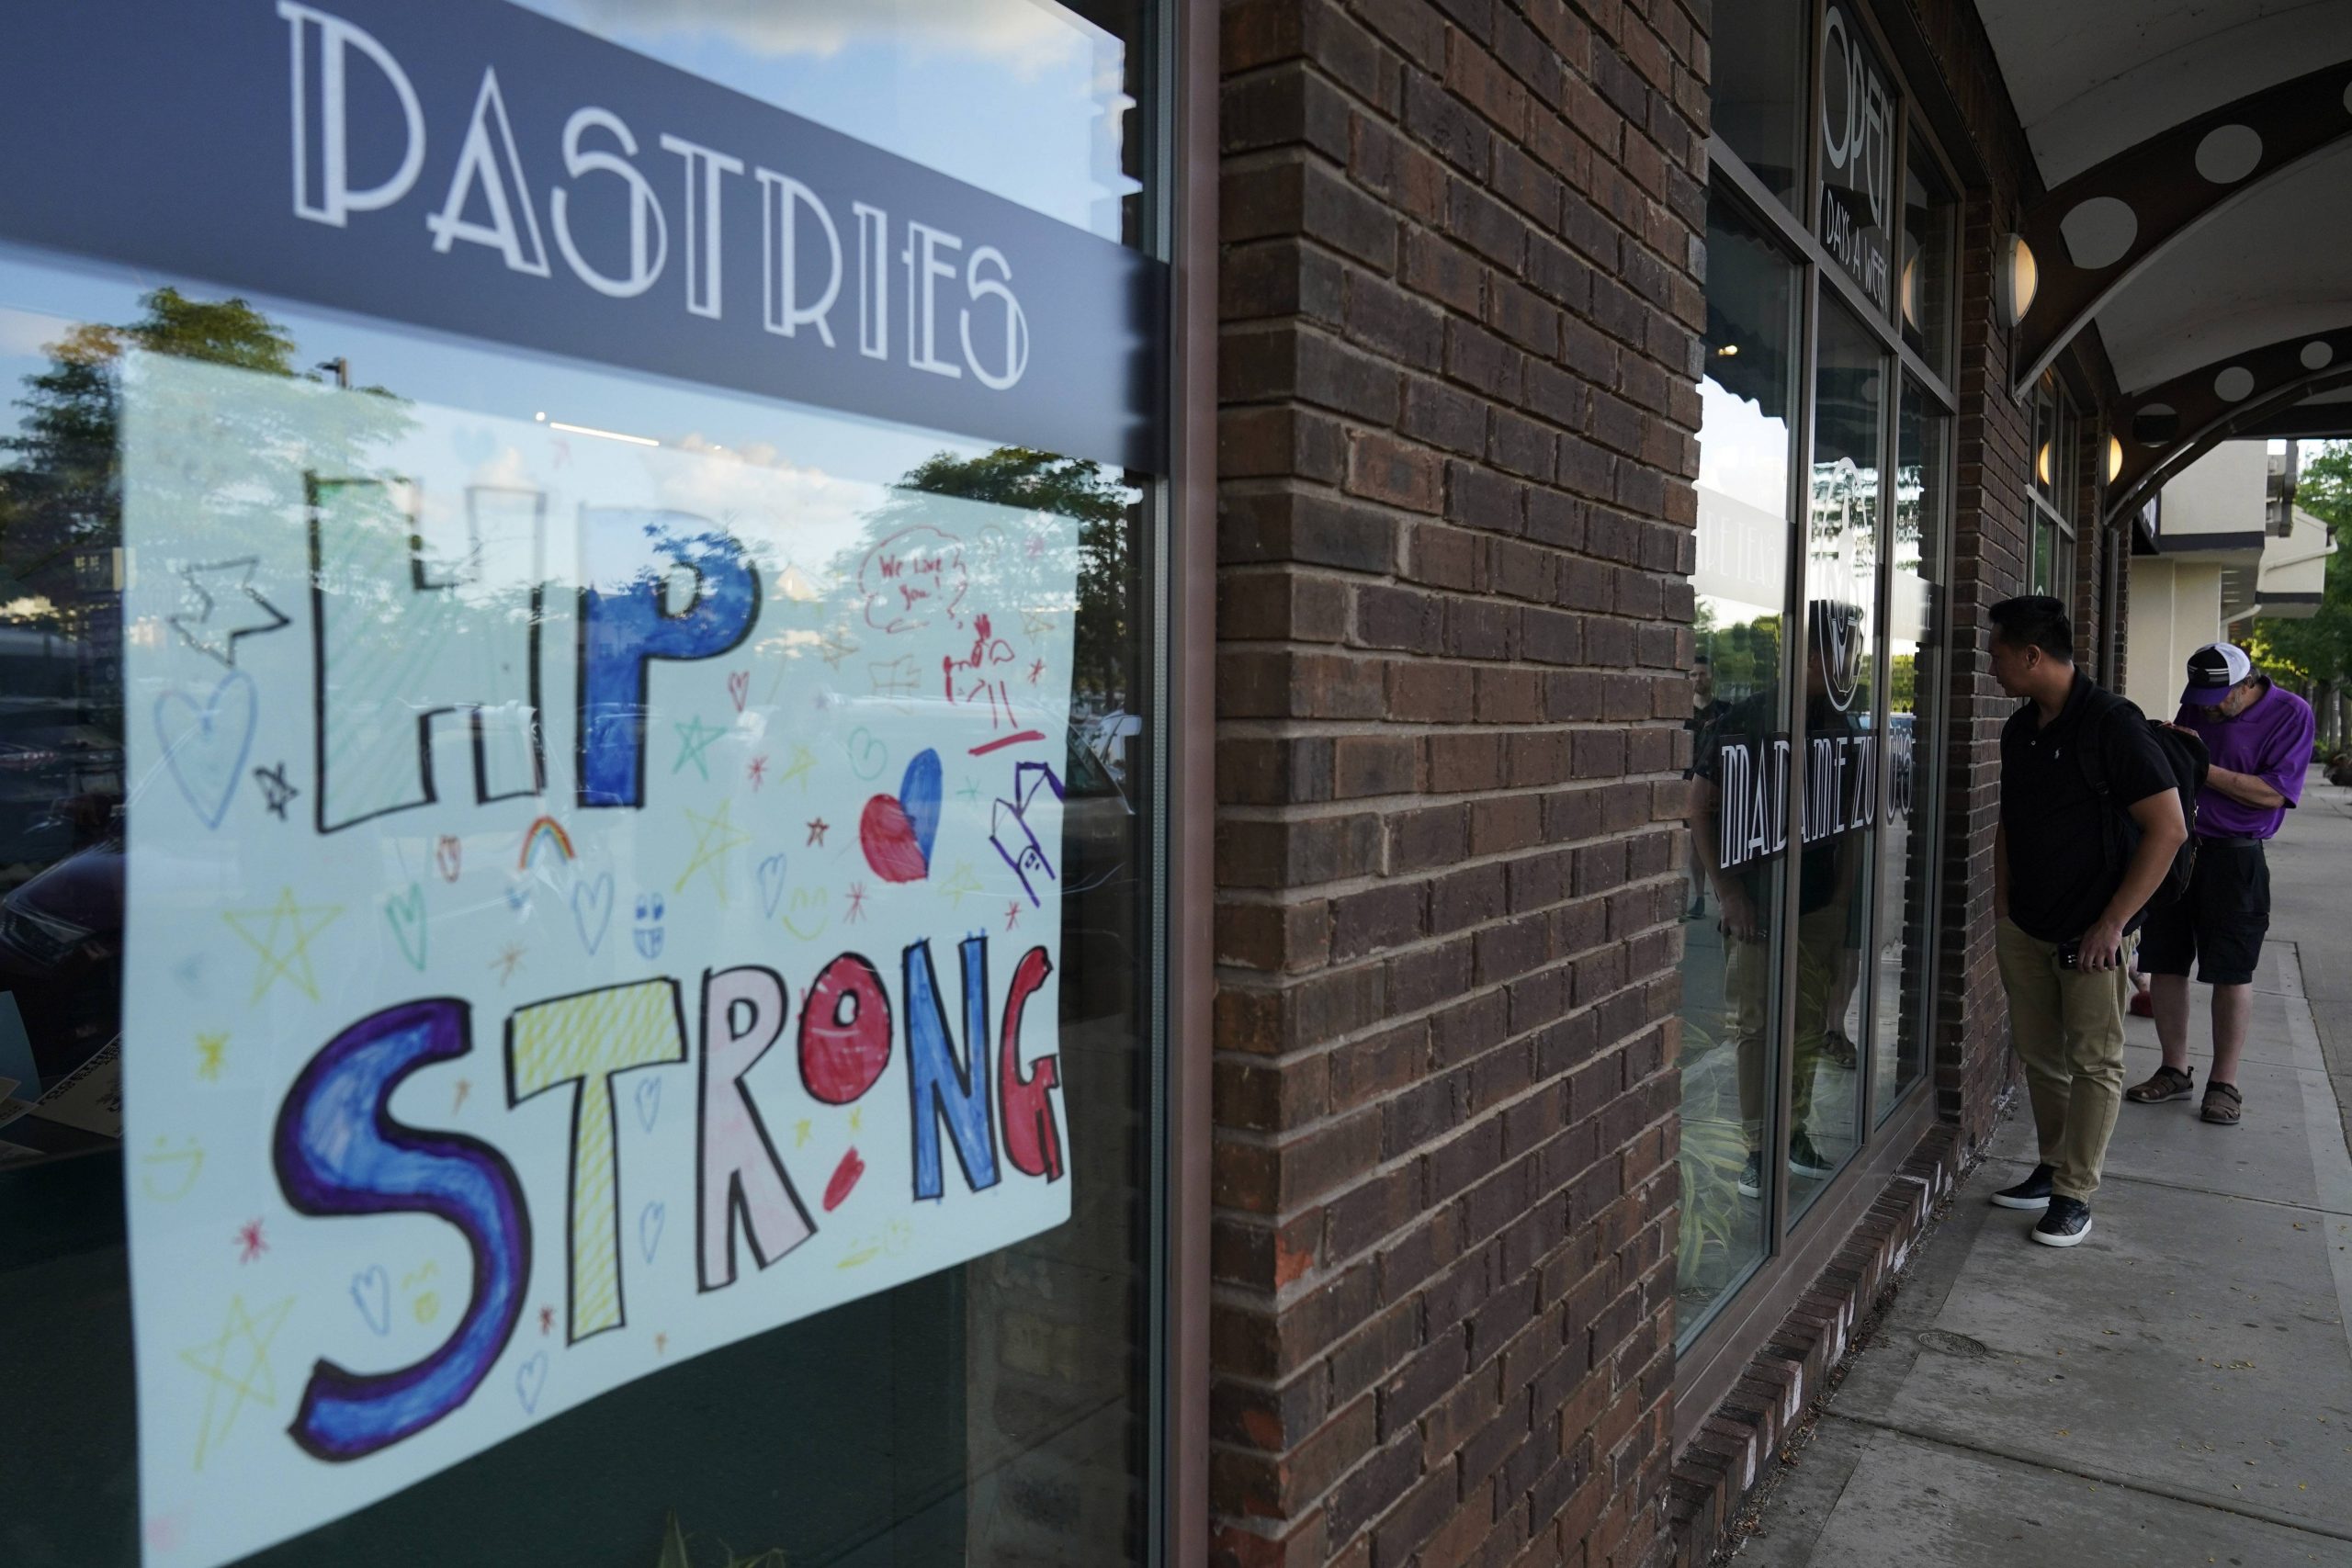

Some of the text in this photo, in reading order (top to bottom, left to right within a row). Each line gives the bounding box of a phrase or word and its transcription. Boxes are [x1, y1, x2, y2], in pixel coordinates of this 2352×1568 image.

[277, 0, 1029, 391] PASTRIES
[1824, 6, 1893, 242] OPEN
[1826, 188, 1888, 313] DAYS A WEEK
[303, 469, 762, 834] HP
[1720, 733, 1913, 869] MADAME ZUU'S
[273, 931, 1064, 1465] STRONG
